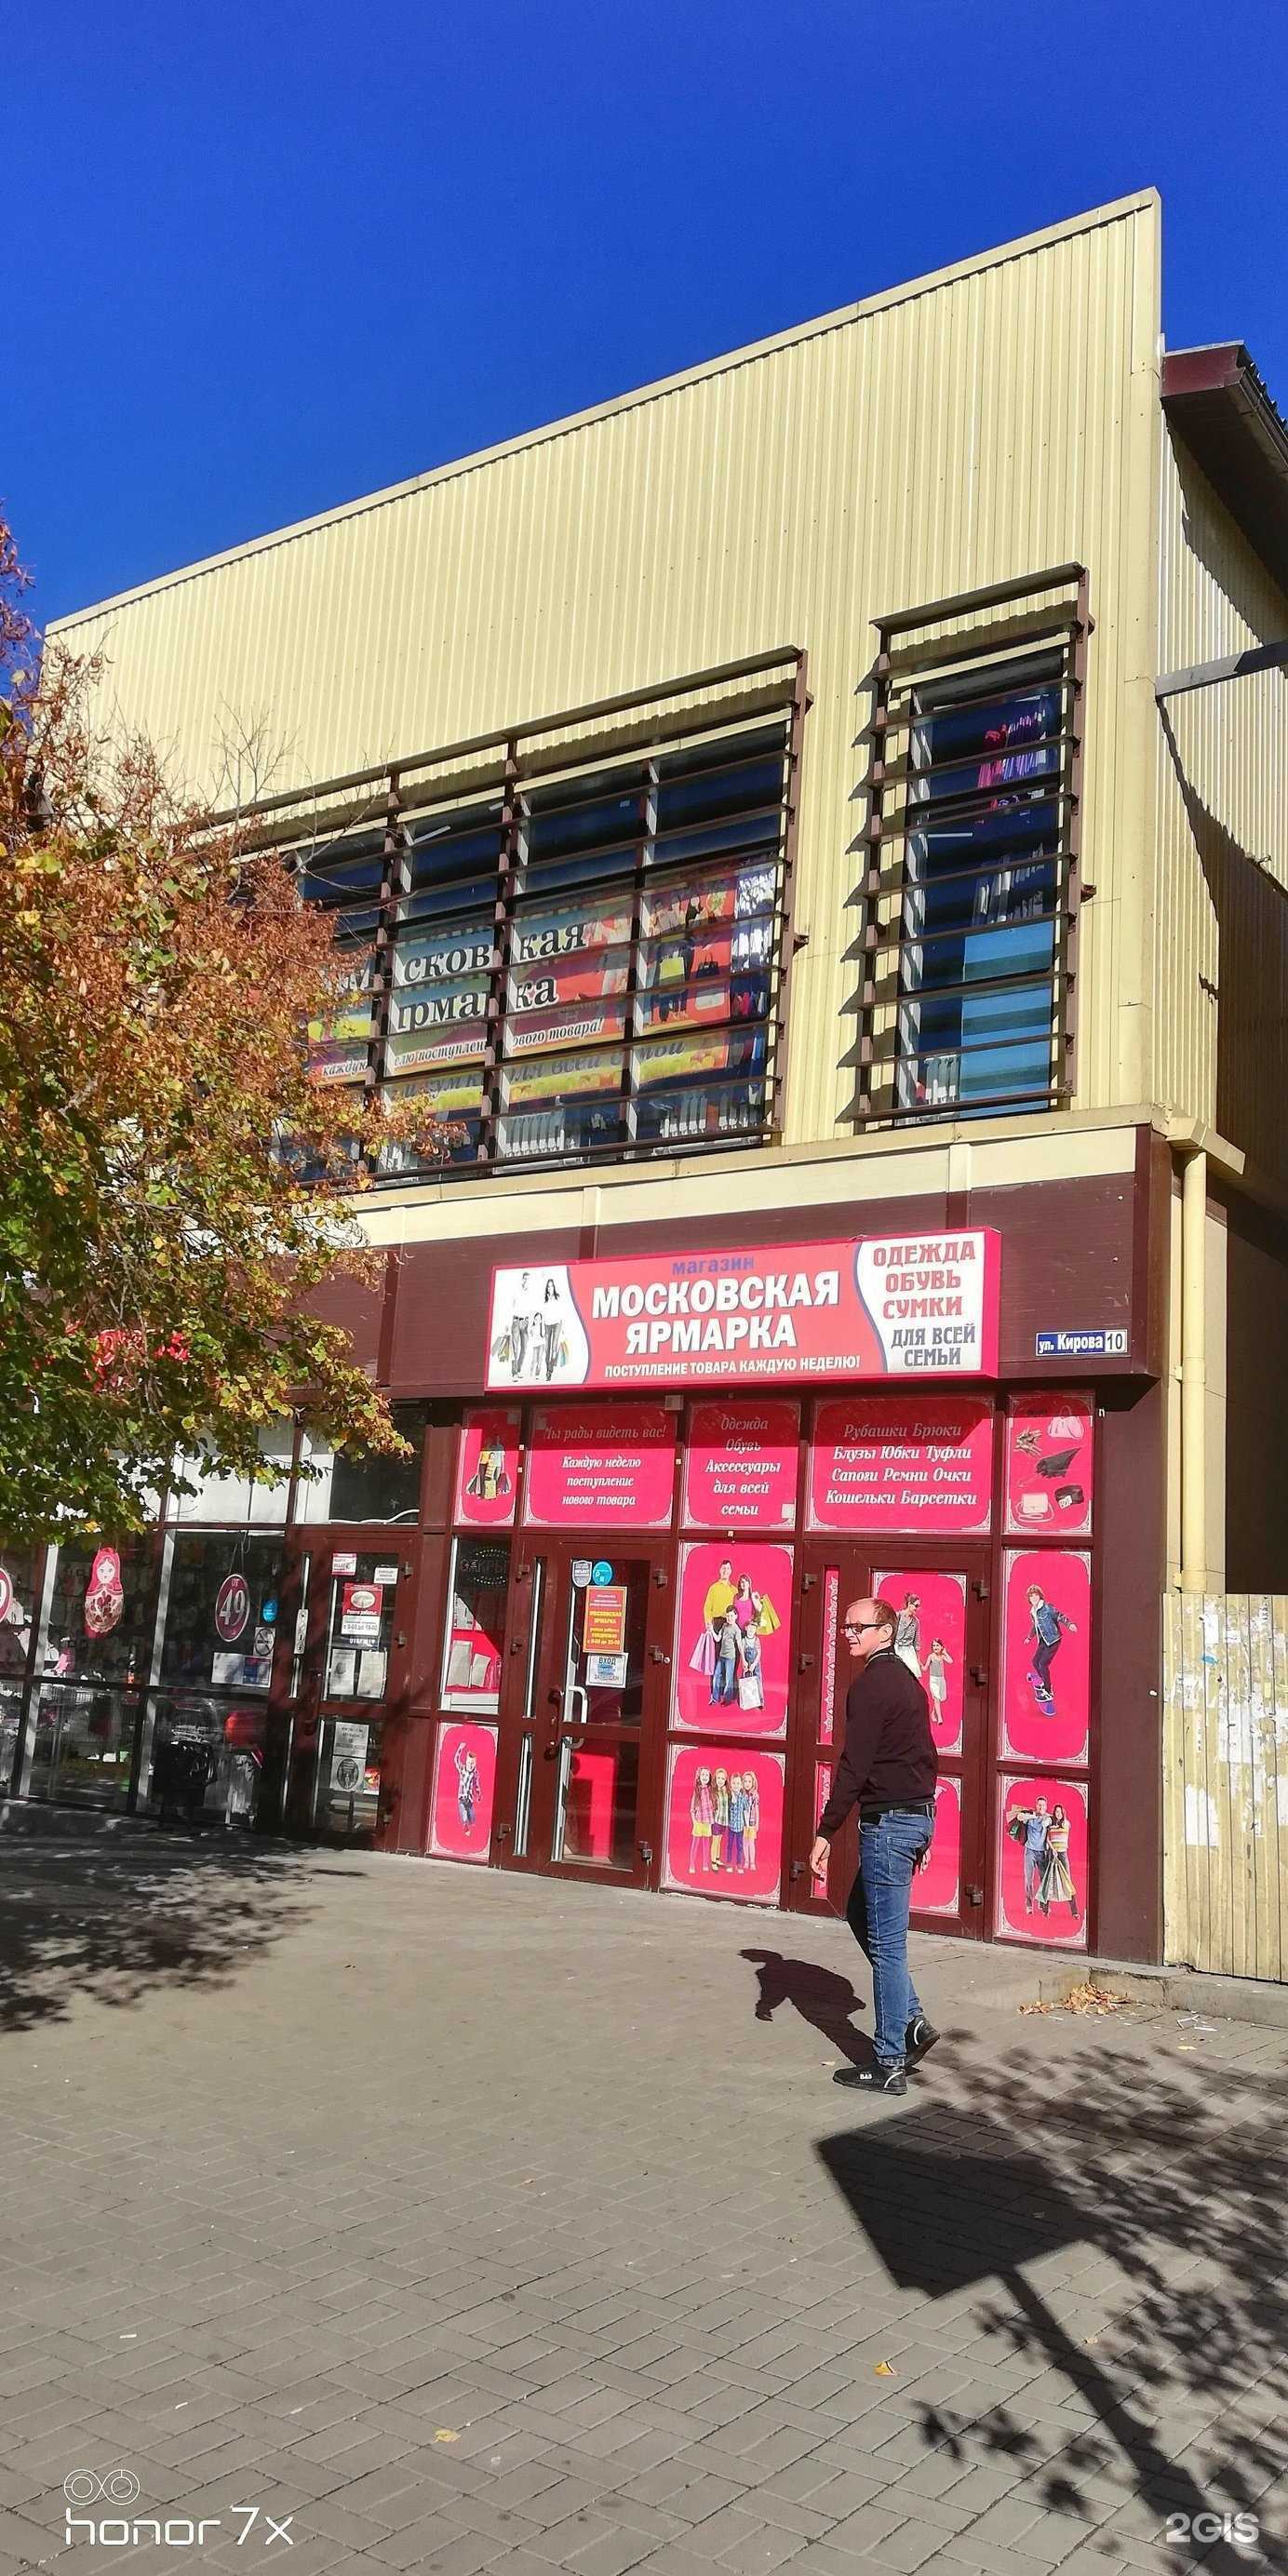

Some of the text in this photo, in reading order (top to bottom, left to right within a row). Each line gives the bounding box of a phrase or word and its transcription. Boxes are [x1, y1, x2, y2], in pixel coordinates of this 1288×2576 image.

[548, 1017, 603, 1040] товара!
[873, 1241, 976, 1268] ОДЕЖДА
[671, 1256, 755, 1276] магазин
[885, 1268, 961, 1293] ОБУВЬ
[591, 1270, 839, 1319] МОСКОВСКАЯ
[882, 1296, 963, 1320] СУМКИ
[624, 1314, 798, 1355] ЯРМАРКА
[891, 1322, 976, 1349] ДЛЯ ВСЕЙ
[1039, 1333, 1123, 1354] ул. Кирова 10
[604, 1355, 861, 1378] ПОСТУПЛЕНИЕ ТОВАРА КАЖДУЮ НЕДЕЛЮ!
[904, 1348, 961, 1367] СЕМЬИ
[720, 1413, 769, 1431] Одежда
[843, 1421, 962, 1441] Рубашки Брюки
[563, 1427, 594, 1442] рады
[596, 1426, 639, 1440] видеть
[642, 1424, 666, 1439] вас!
[725, 1438, 762, 1455] Обувь
[832, 1444, 973, 1463] Блузы Юбки Туфли
[561, 1456, 642, 1471] Каждую неделю
[704, 1461, 782, 1476] Аксессуары
[566, 1475, 635, 1489] поступление
[831, 1467, 972, 1483] Сапоги Ремни Очки
[713, 1480, 771, 1495] для всей
[561, 1495, 637, 1508] нового товара
[825, 1489, 978, 1507] Кошельки Барсетки
[721, 1504, 759, 1517] семьи
[219, 1590, 246, 1626] 49
